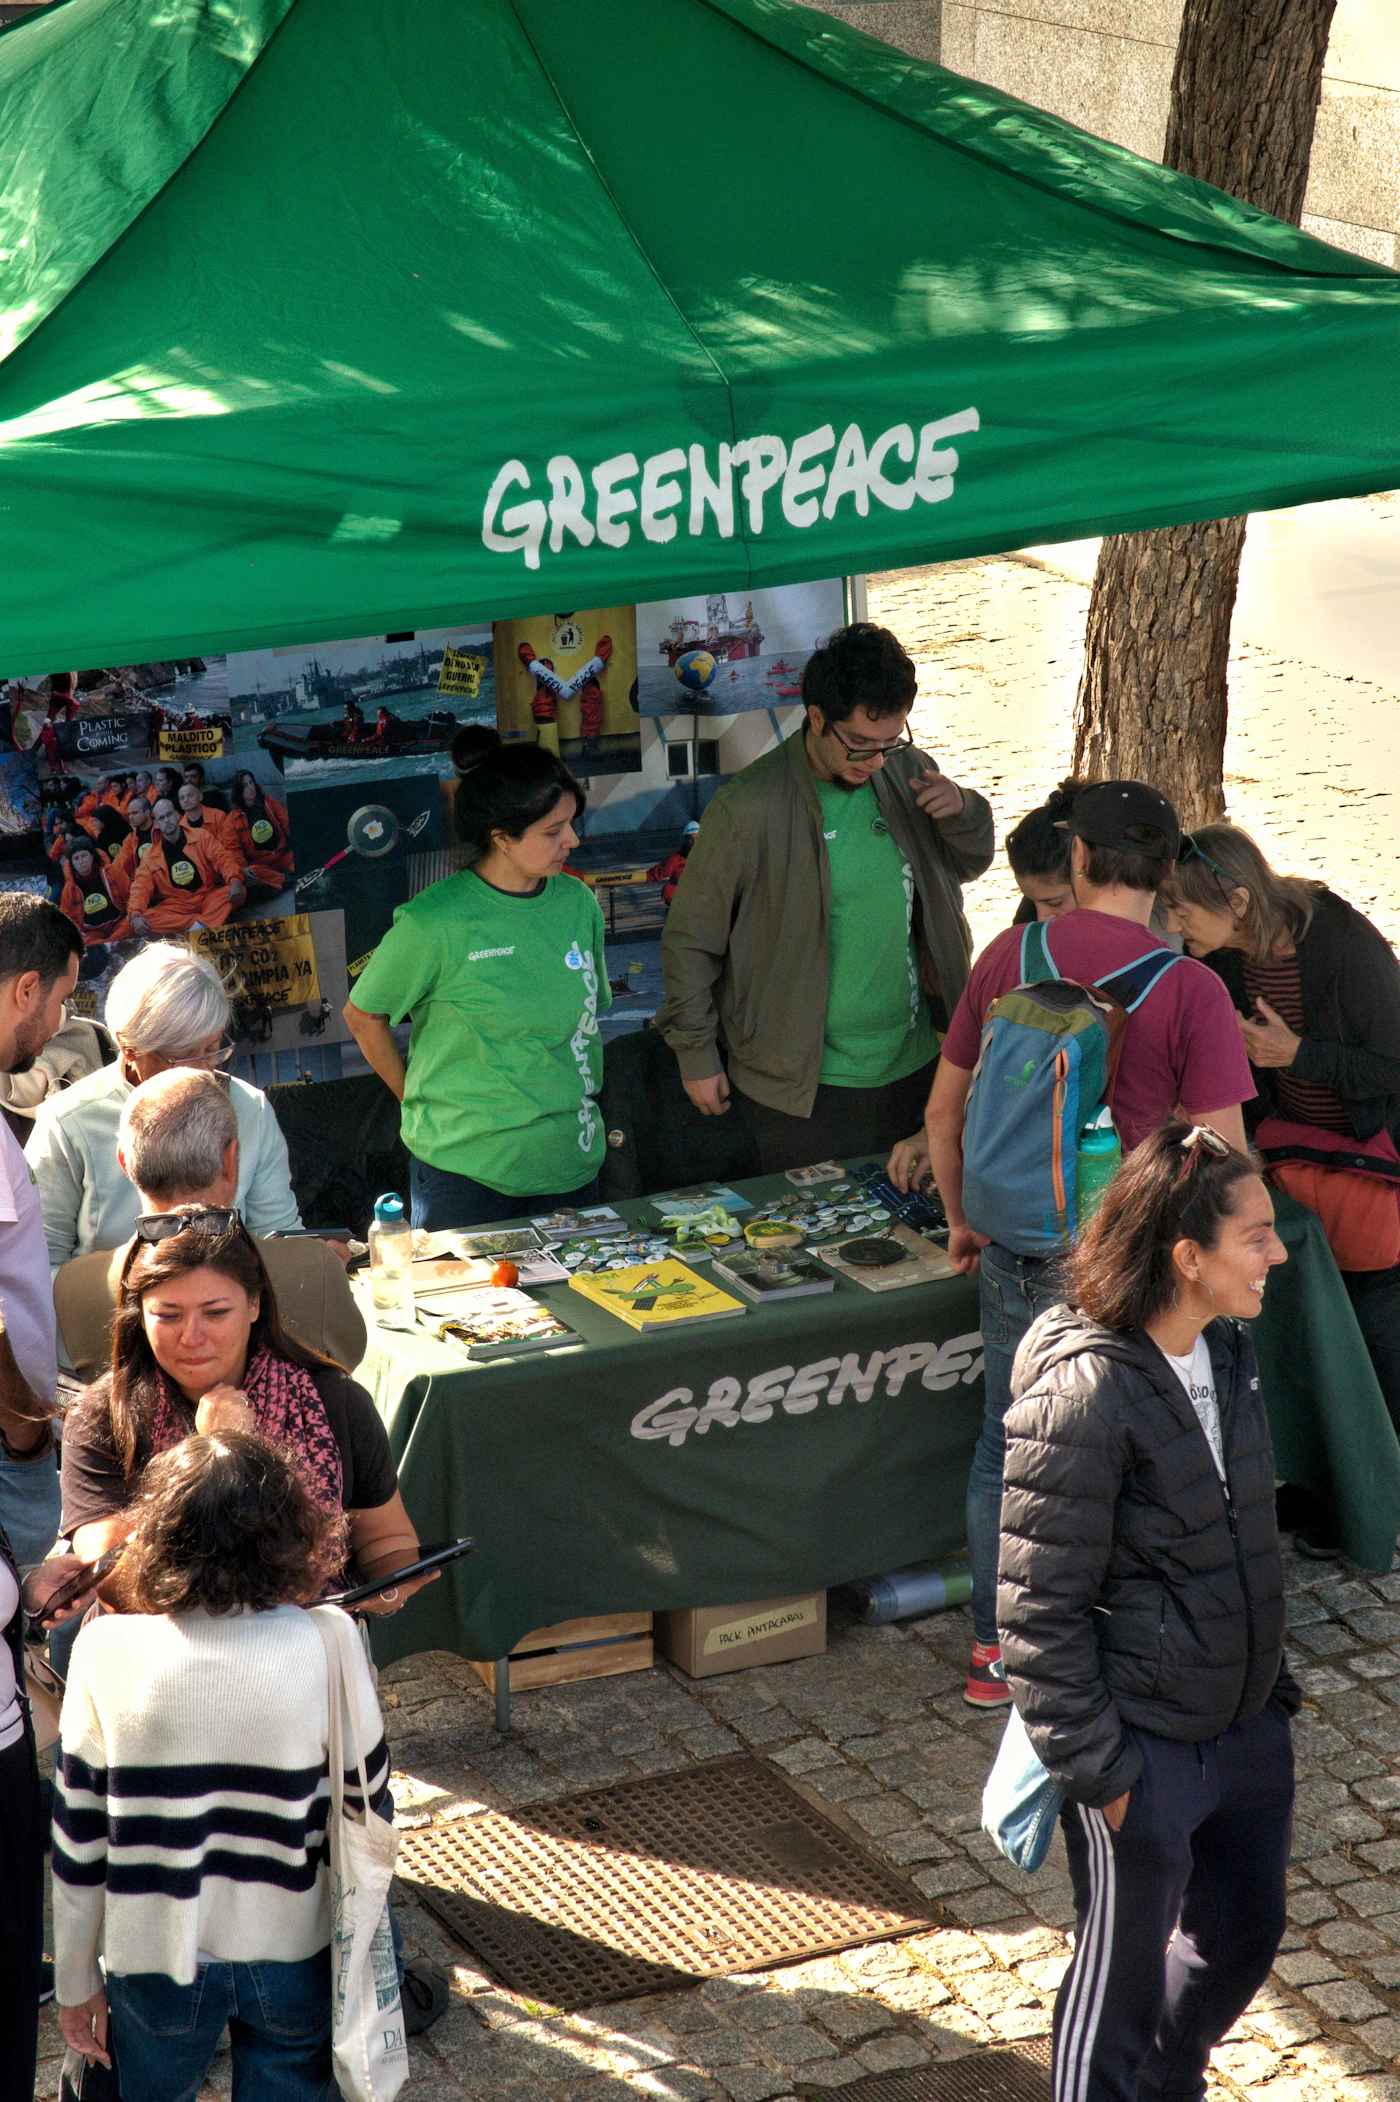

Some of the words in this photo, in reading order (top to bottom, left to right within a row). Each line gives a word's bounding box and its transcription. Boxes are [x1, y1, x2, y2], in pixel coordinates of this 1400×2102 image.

[481, 406, 980, 570] GREENPEACE
[535, 669, 563, 693] GREEN
[79, 718, 126, 736] PLASTIC
[167, 730, 214, 742] MALDITO
[77, 733, 128, 751] COMING
[328, 745, 390, 754] GREENPEACE
[198, 921, 285, 946] GREENPEACE
[468, 946, 515, 961] GREENPEACE
[295, 960, 313, 976] YA
[630, 1331, 984, 1446] GREENPE
[719, 1631, 742, 1645] PACK
